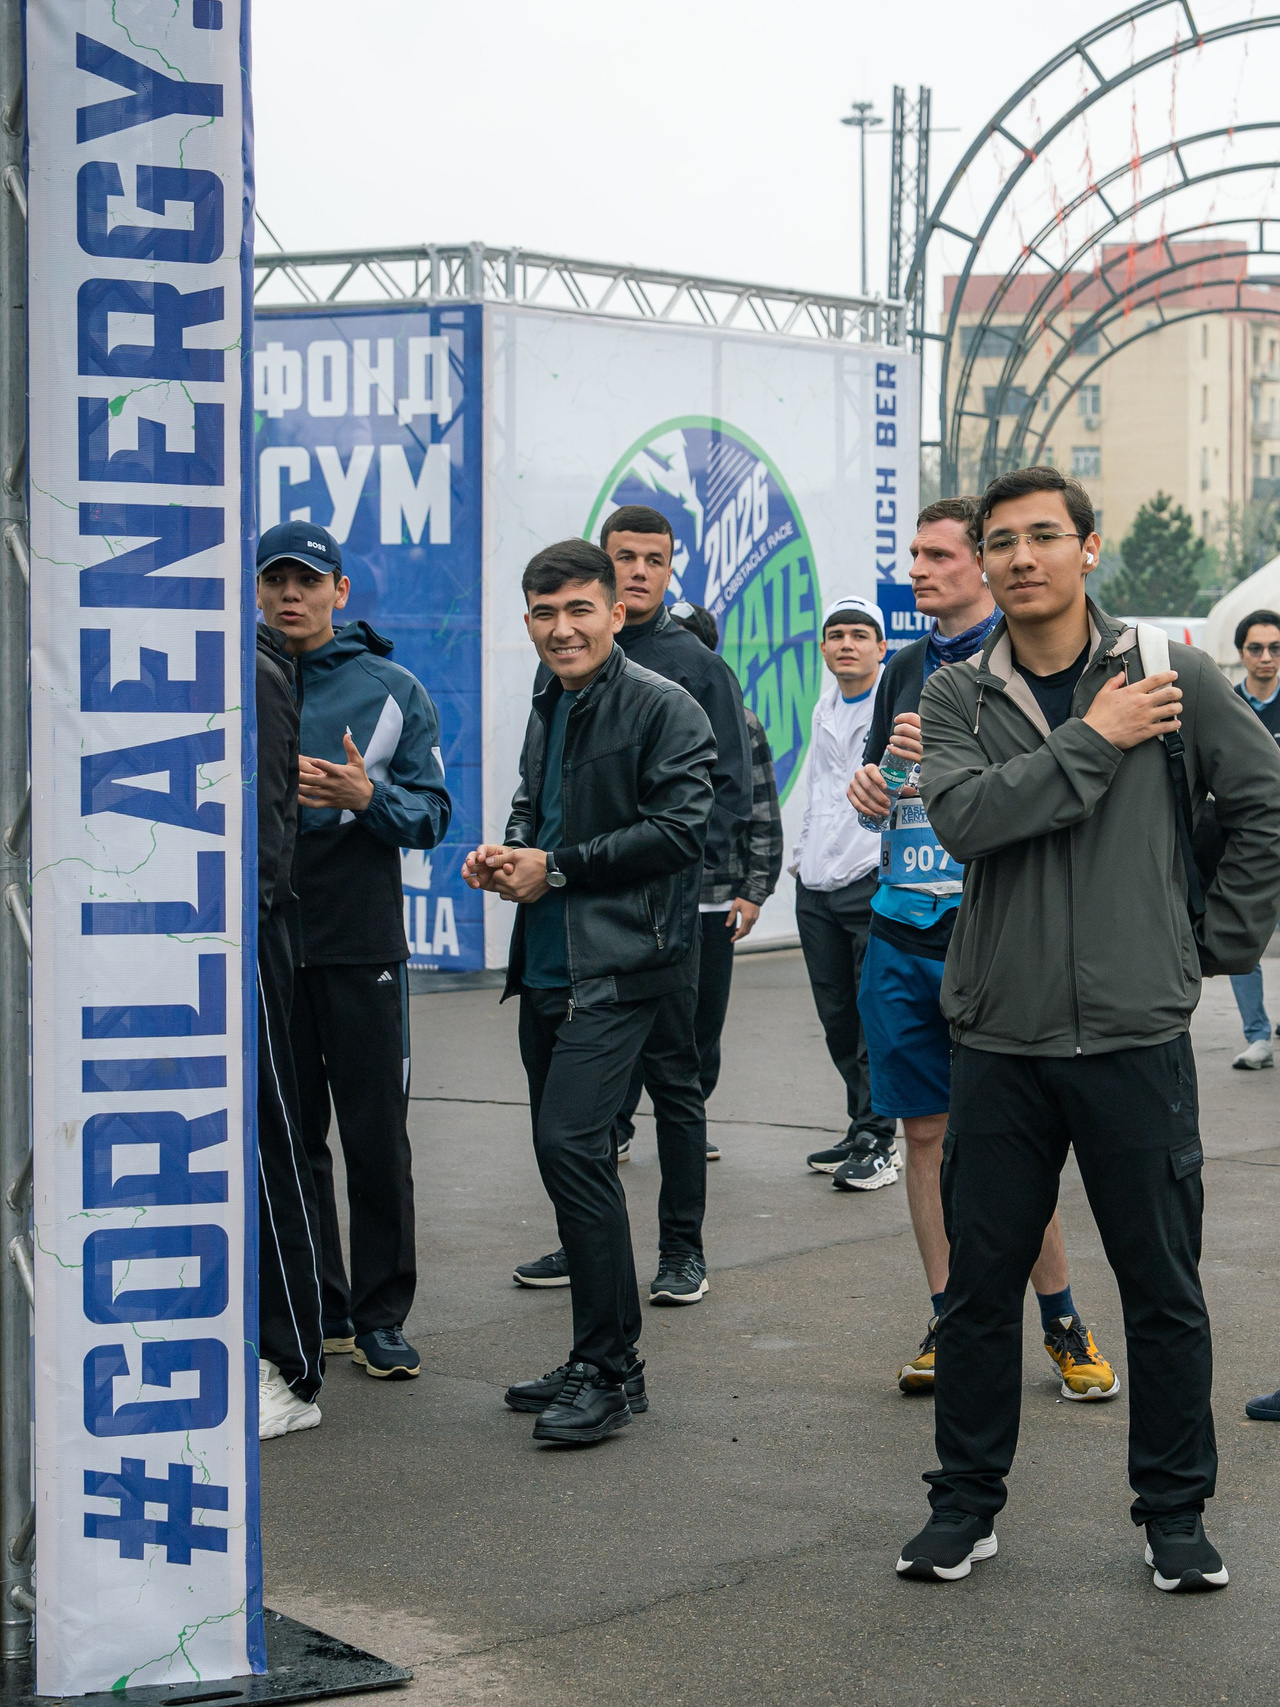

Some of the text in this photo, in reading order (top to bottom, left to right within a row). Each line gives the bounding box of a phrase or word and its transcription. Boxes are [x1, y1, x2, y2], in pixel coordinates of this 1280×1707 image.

[254, 335, 453, 427] ФОНД
[259, 443, 451, 546] СУМ
[875, 362, 897, 584] KUCH BER
[307, 540, 327, 552] BOSS
[704, 460, 769, 613] 2026
[723, 542, 769, 600] OBSTACLE
[766, 520, 794, 551] RACE
[891, 611, 932, 631] ULTI
[882, 851, 890, 867] B
